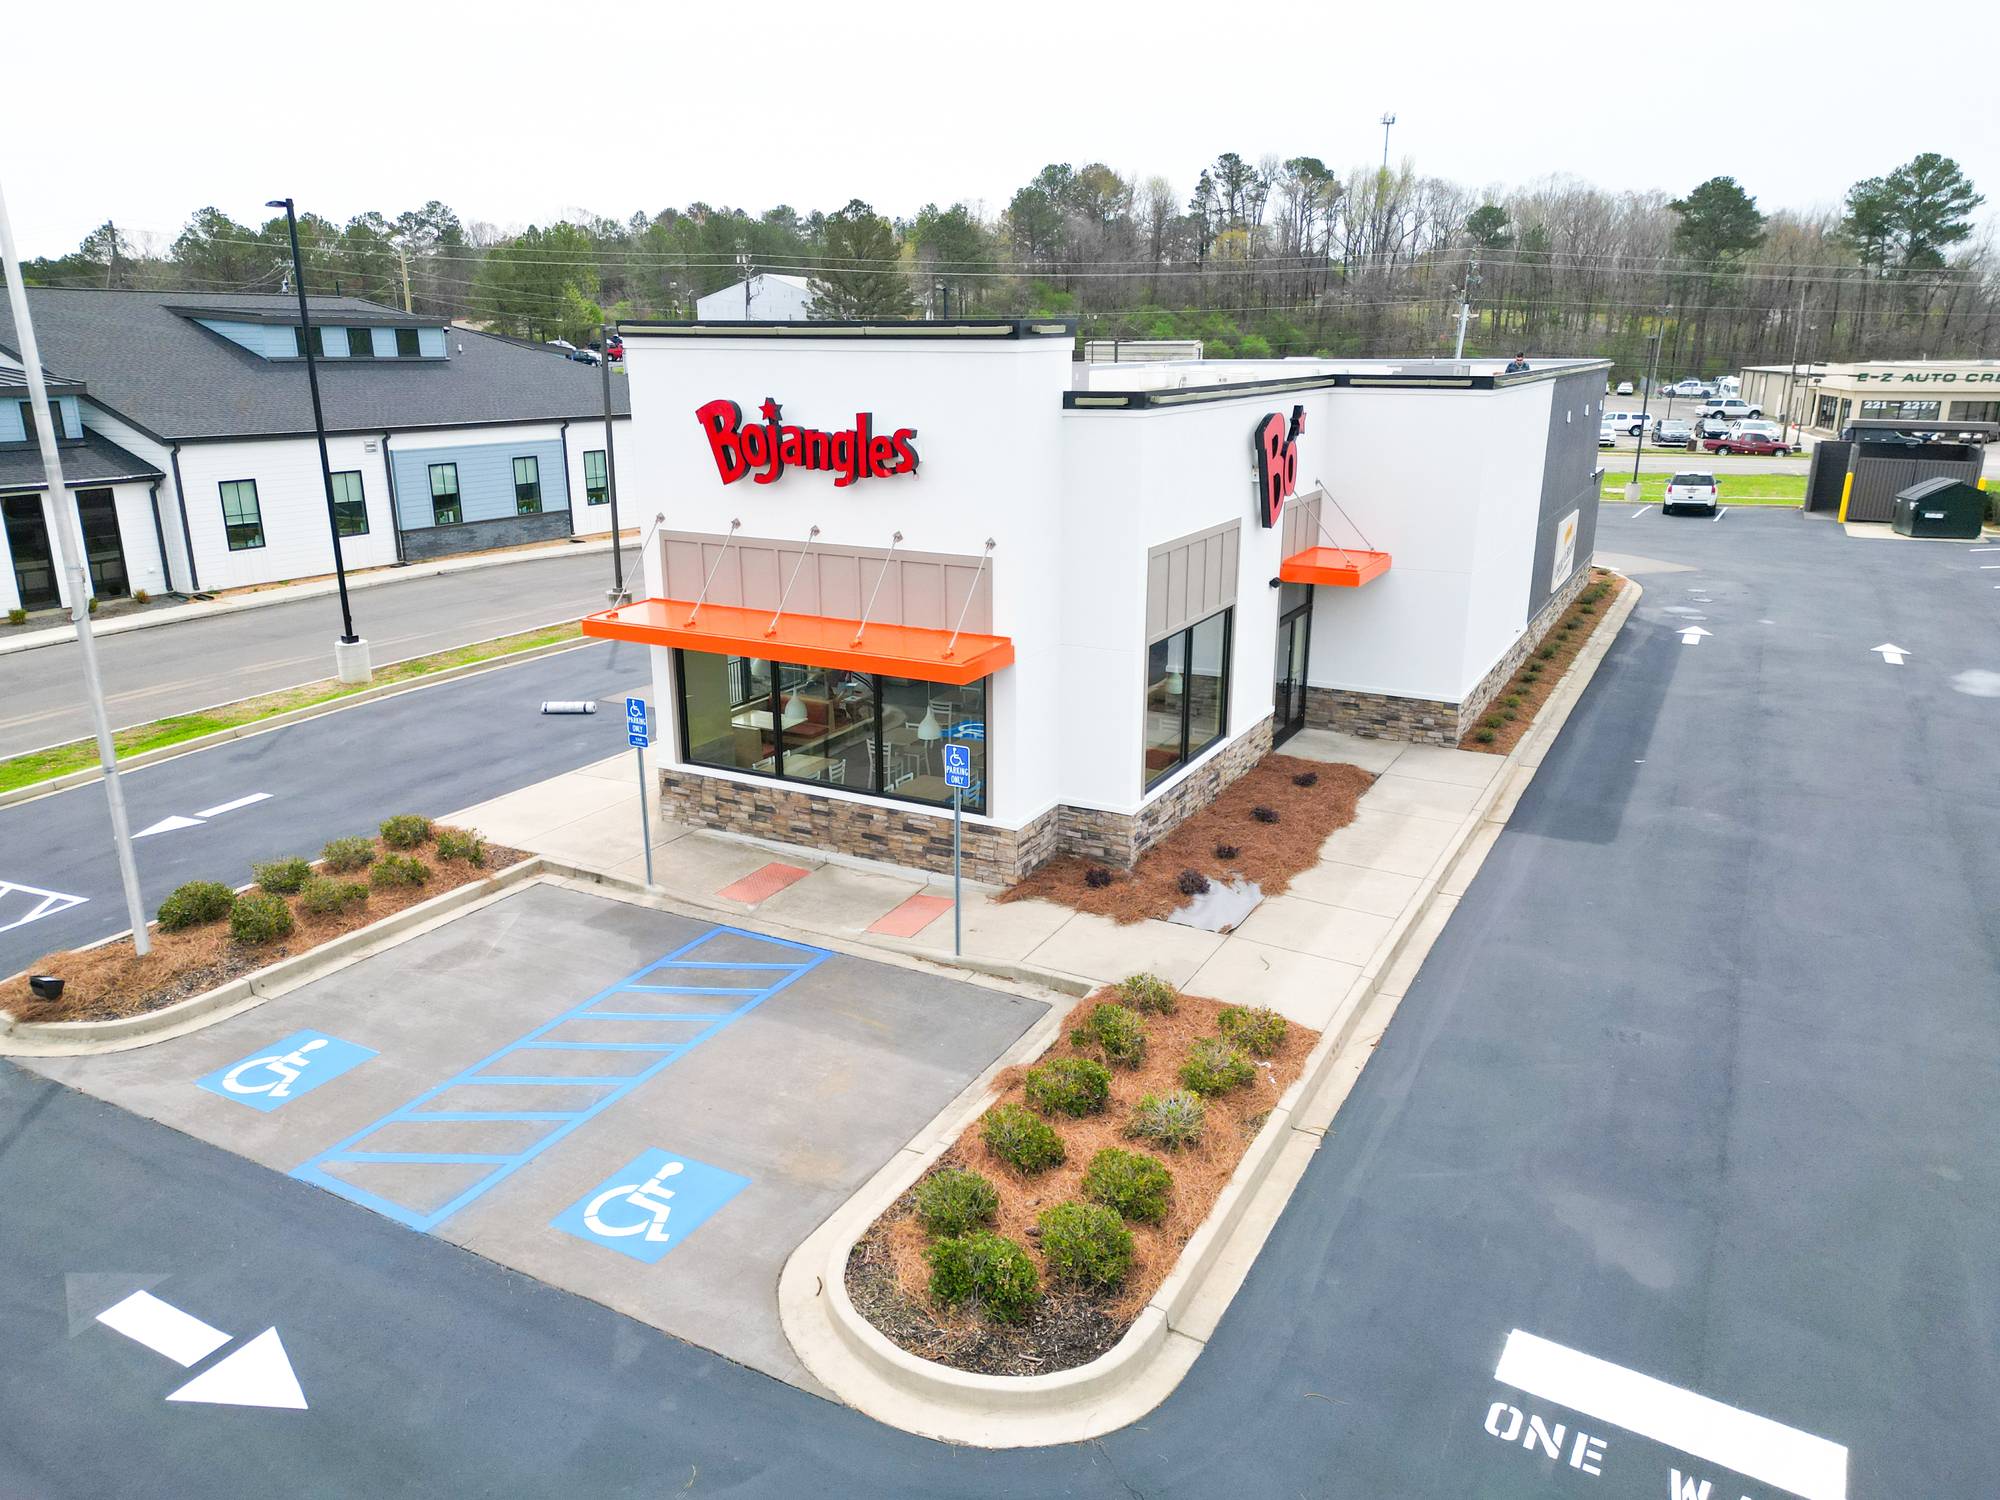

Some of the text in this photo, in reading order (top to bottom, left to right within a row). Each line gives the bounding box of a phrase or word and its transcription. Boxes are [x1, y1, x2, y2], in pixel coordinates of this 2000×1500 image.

[1857, 373, 1893, 382] E-Z
[1902, 373, 1956, 382] AUTO
[1864, 401, 1887, 409] 221
[1903, 401, 1938, 410] 2277
[695, 396, 920, 487] Bojangles
[632, 725, 643, 733] ONLY
[946, 765, 969, 776] PARKING
[950, 775, 965, 785] ONLY
[1484, 1402, 1607, 1476] ONE
